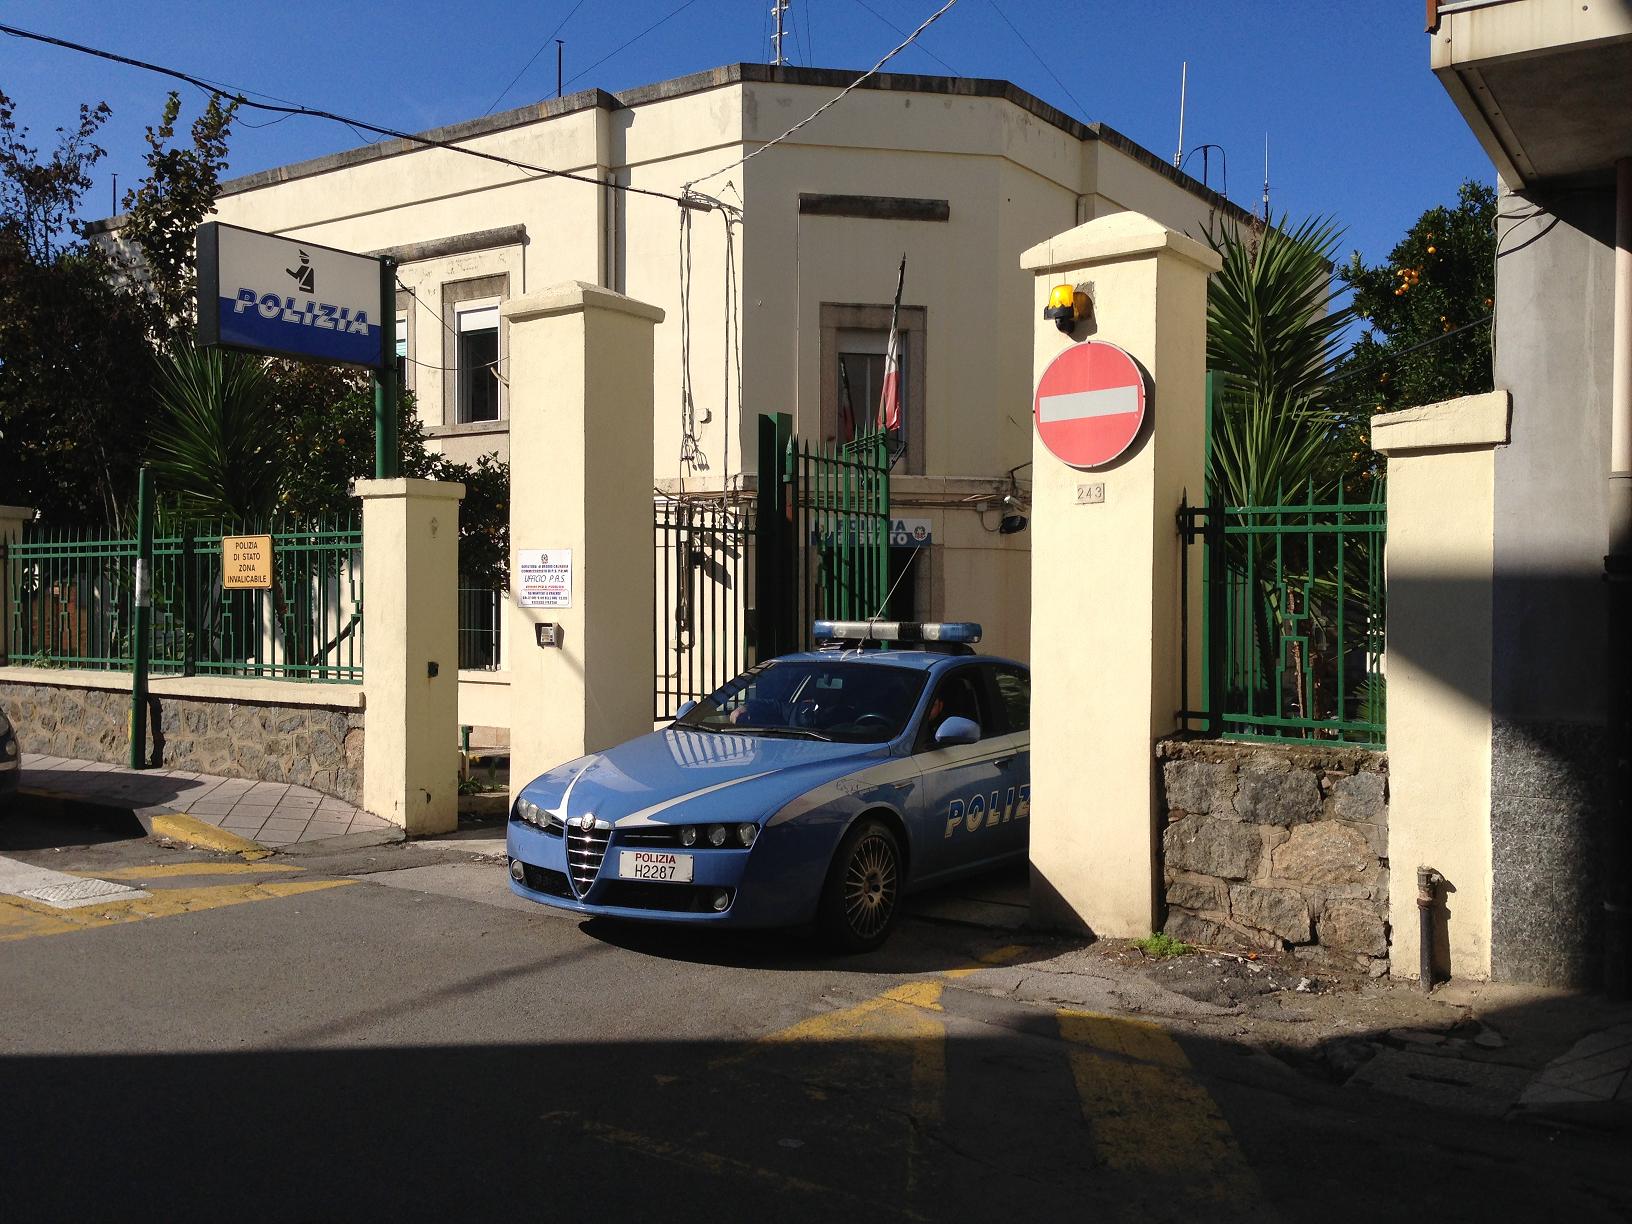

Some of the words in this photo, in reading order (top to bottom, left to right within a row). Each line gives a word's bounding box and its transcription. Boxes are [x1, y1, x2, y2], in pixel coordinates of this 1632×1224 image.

[233, 287, 369, 336] POLIZIA
[1077, 486, 1102, 500] 243
[837, 519, 906, 532] POLIA
[235, 541, 258, 550] POLIZIA
[233, 553, 240, 561] DI
[242, 552, 261, 561] STATO
[238, 564, 256, 572] ZONA
[227, 575, 267, 583] INVALICABILE
[635, 852, 676, 864] POLIZIA
[634, 864, 676, 880] H2287
